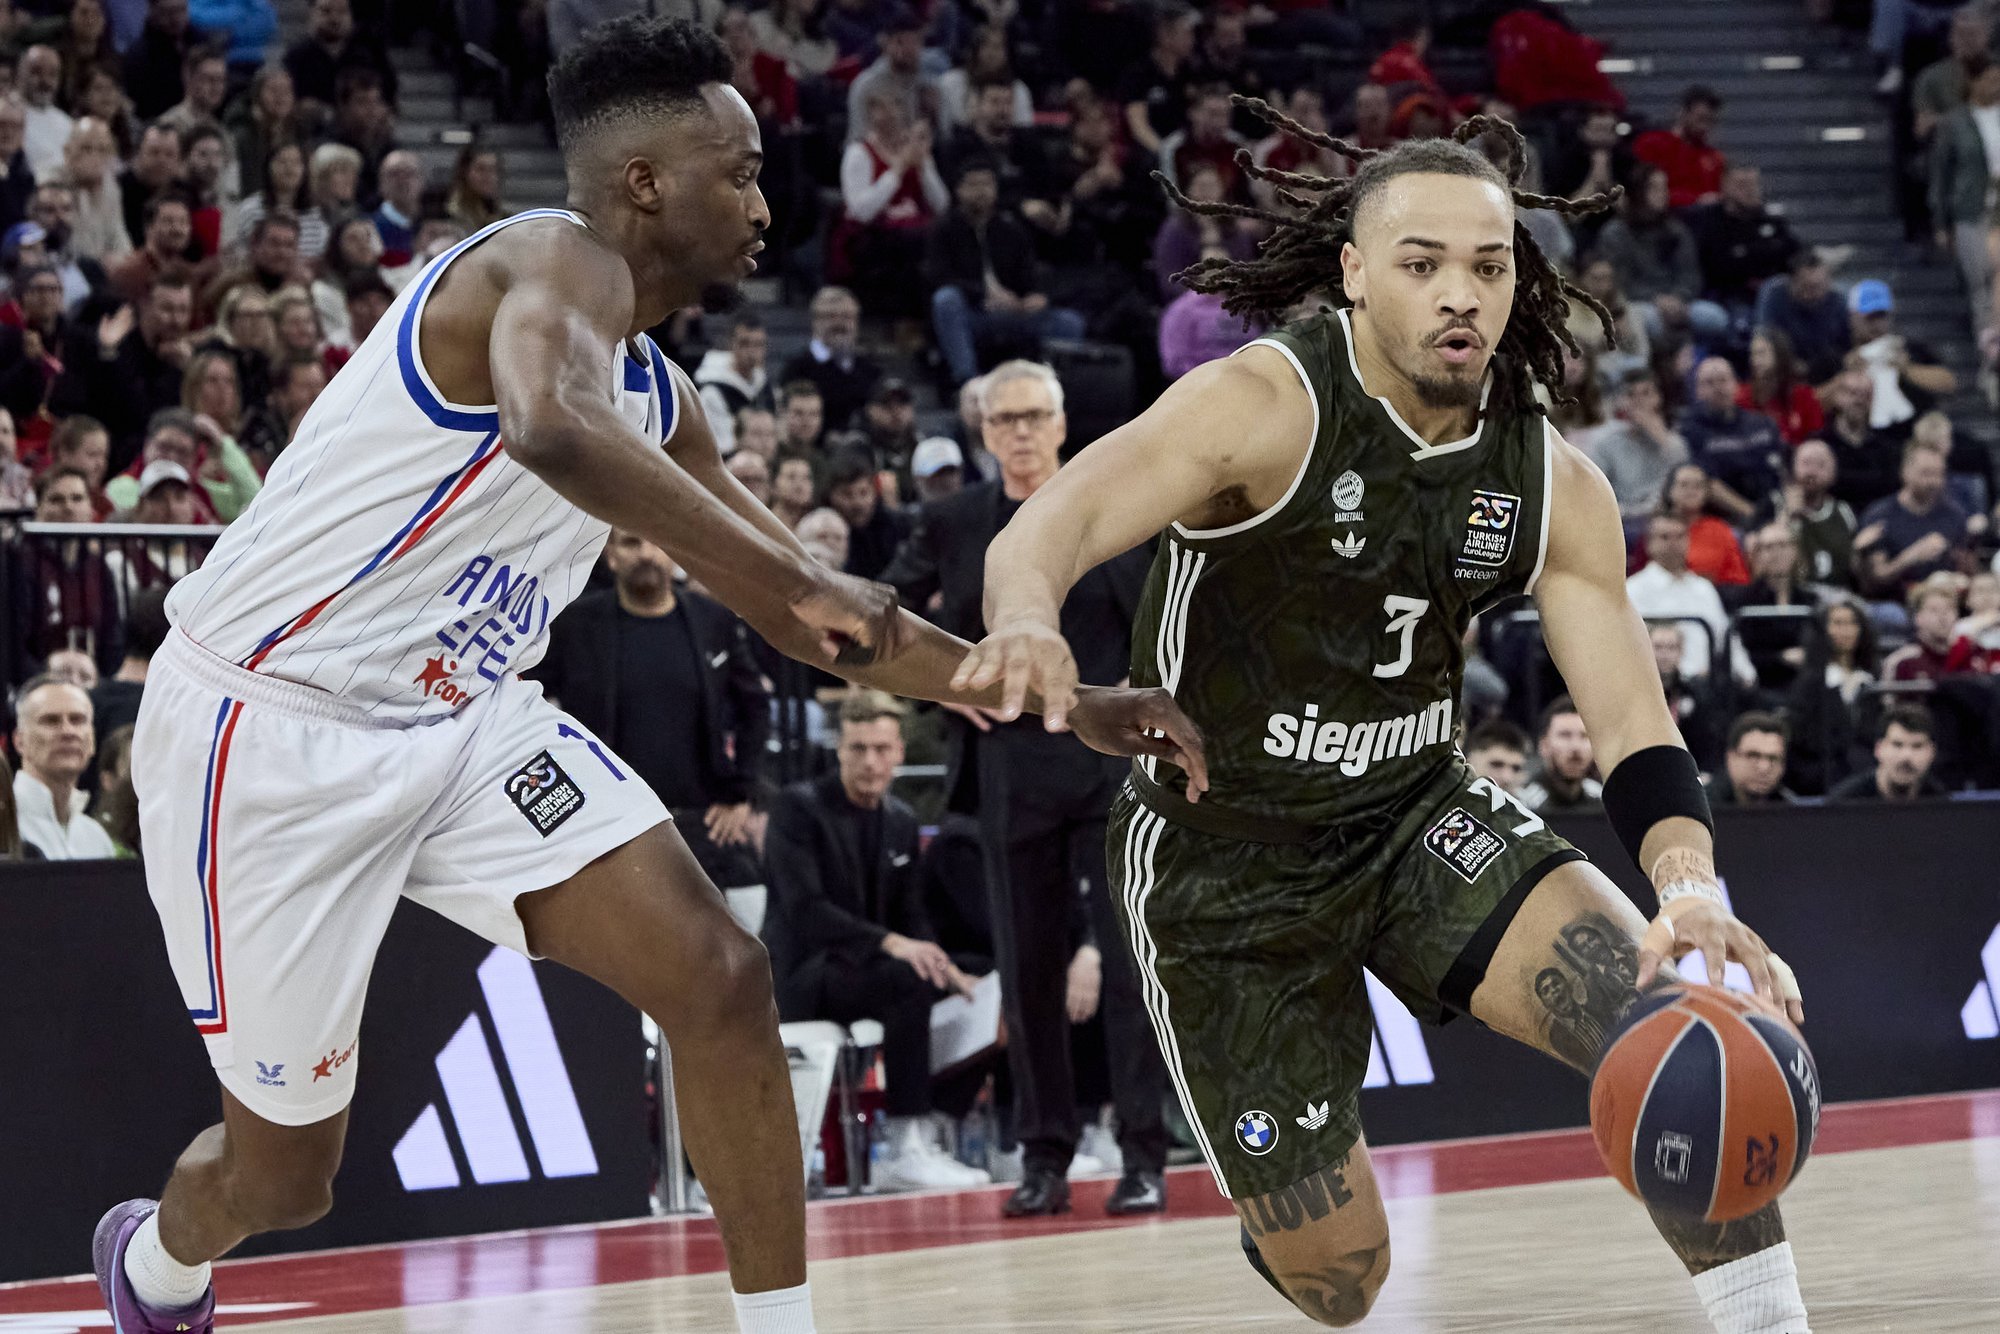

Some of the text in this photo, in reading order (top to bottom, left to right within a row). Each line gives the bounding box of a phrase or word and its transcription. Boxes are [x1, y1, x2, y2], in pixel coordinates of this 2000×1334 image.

[1468, 496, 1512, 529] 25
[1463, 546, 1503, 560] EuroLeague
[1465, 539, 1505, 552] AIRLINES
[1467, 530, 1507, 544] TURKISH
[1372, 594, 1430, 679] 3
[1263, 698, 1453, 777] siegmun
[510, 756, 557, 807] 25
[529, 782, 571, 816] TURKISH
[535, 788, 576, 824] AIRLINES
[540, 795, 581, 830] EuroLeague
[1432, 813, 1475, 856] 25
[1454, 831, 1490, 863] TURKISH
[1461, 837, 1495, 869] AIRLINES
[1466, 841, 1501, 873] EuroLeague
[1237, 1113, 1267, 1131] BMW
